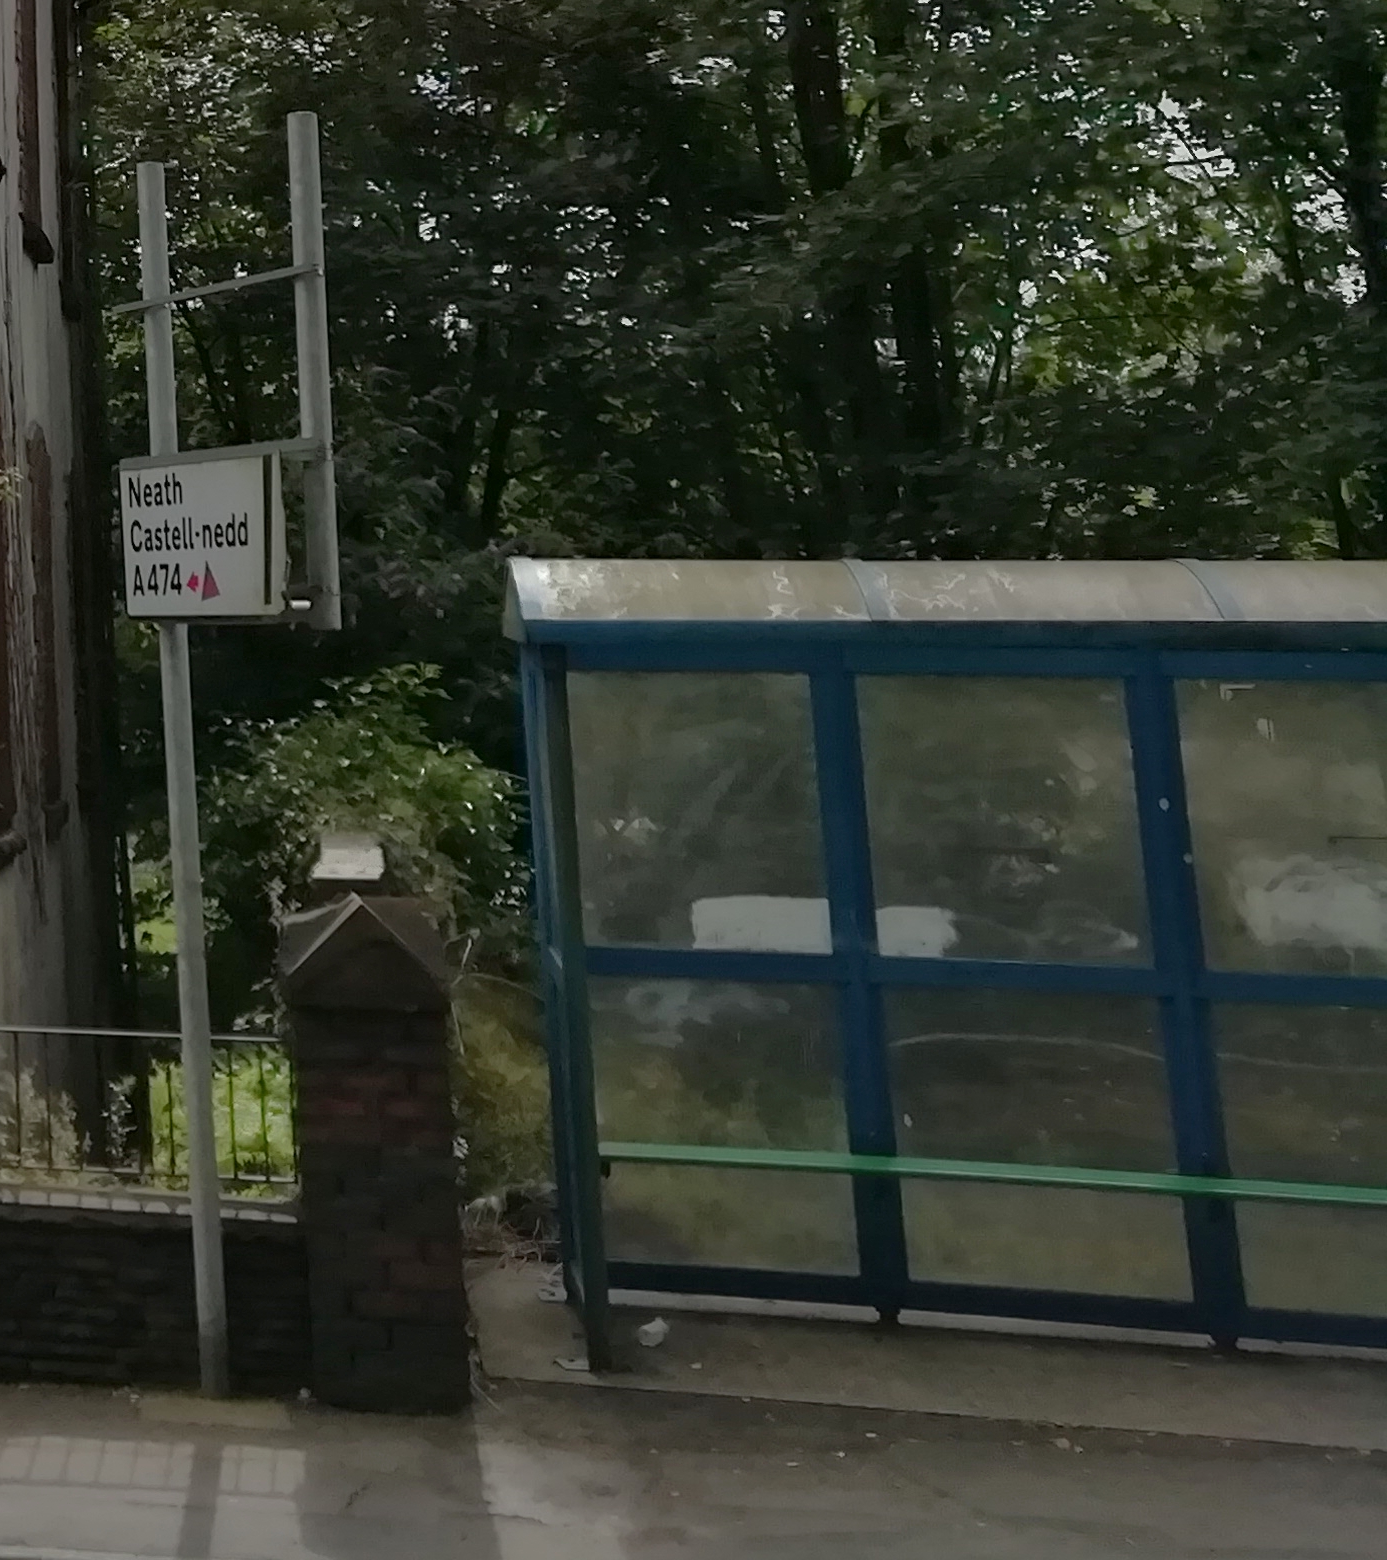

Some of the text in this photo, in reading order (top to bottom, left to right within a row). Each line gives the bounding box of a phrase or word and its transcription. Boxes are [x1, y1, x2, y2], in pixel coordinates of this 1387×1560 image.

[128, 473, 183, 507] Neath
[130, 512, 249, 552] Castell-nedd
[133, 562, 182, 596] A474
